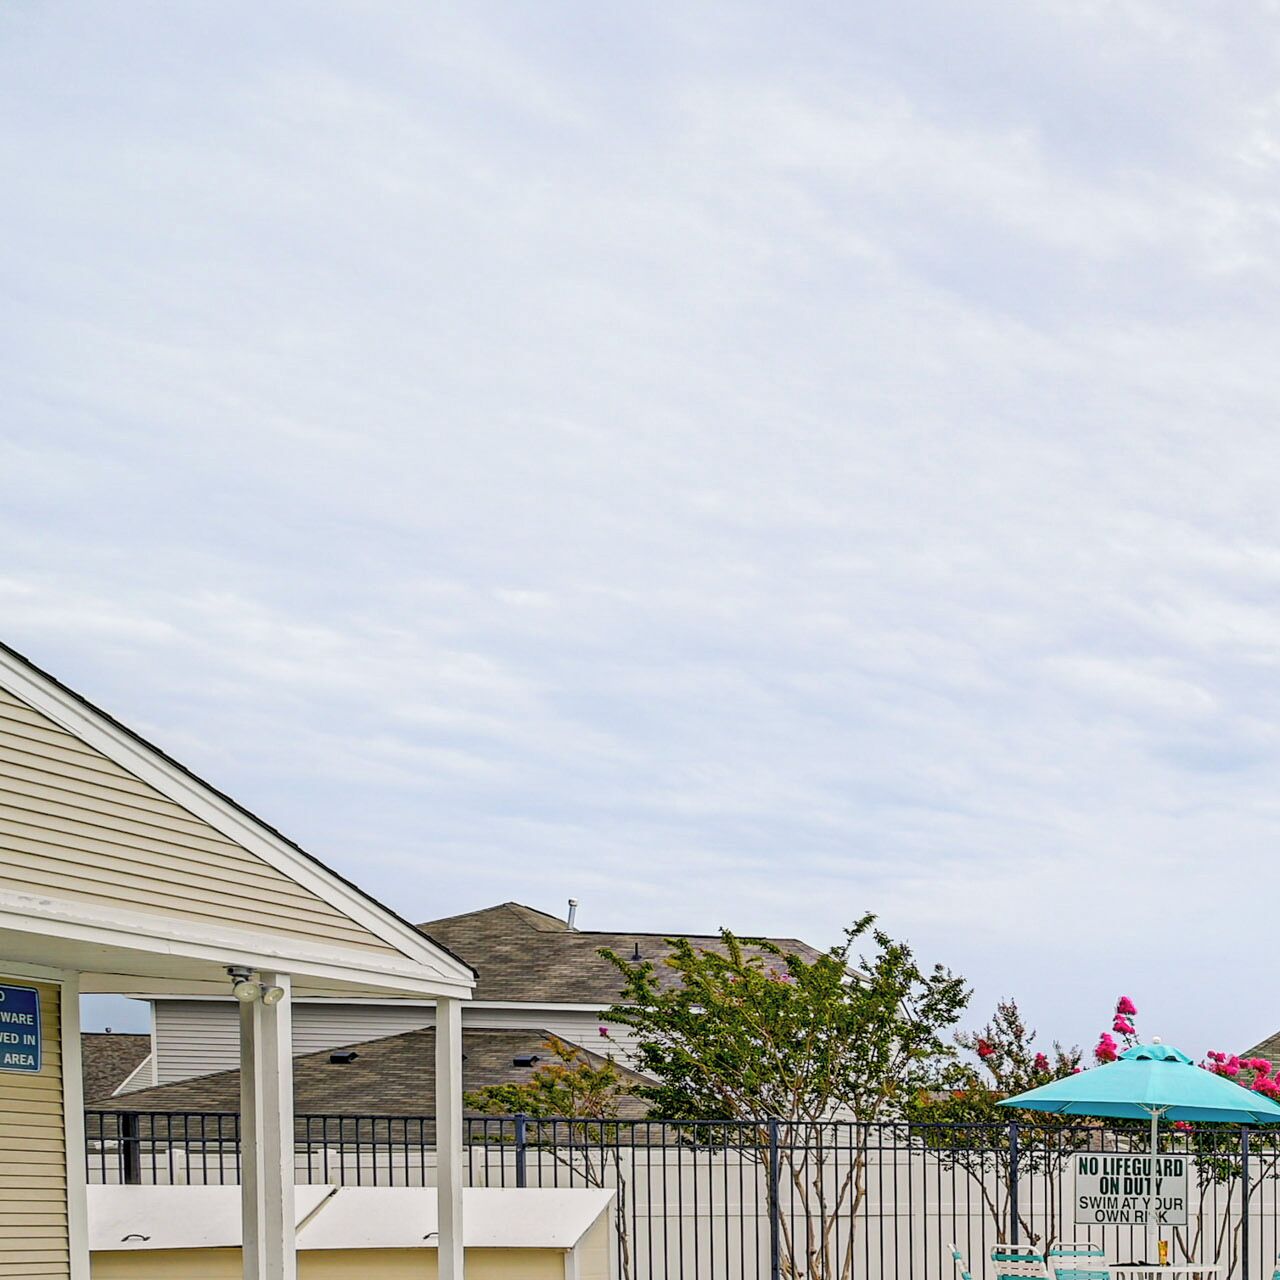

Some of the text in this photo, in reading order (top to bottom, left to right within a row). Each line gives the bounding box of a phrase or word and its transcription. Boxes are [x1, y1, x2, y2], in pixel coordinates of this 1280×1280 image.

[0, 1032, 36, 1046] ED IN
[3, 1053, 35, 1066] AREA
[1079, 1157, 1183, 1177] NO LIFEGUARD
[1100, 1177, 1164, 1196] ON DUTY
[1079, 1196, 1183, 1211] SWIM AT YOUR
[1095, 1209, 1168, 1223] OWN RIK
